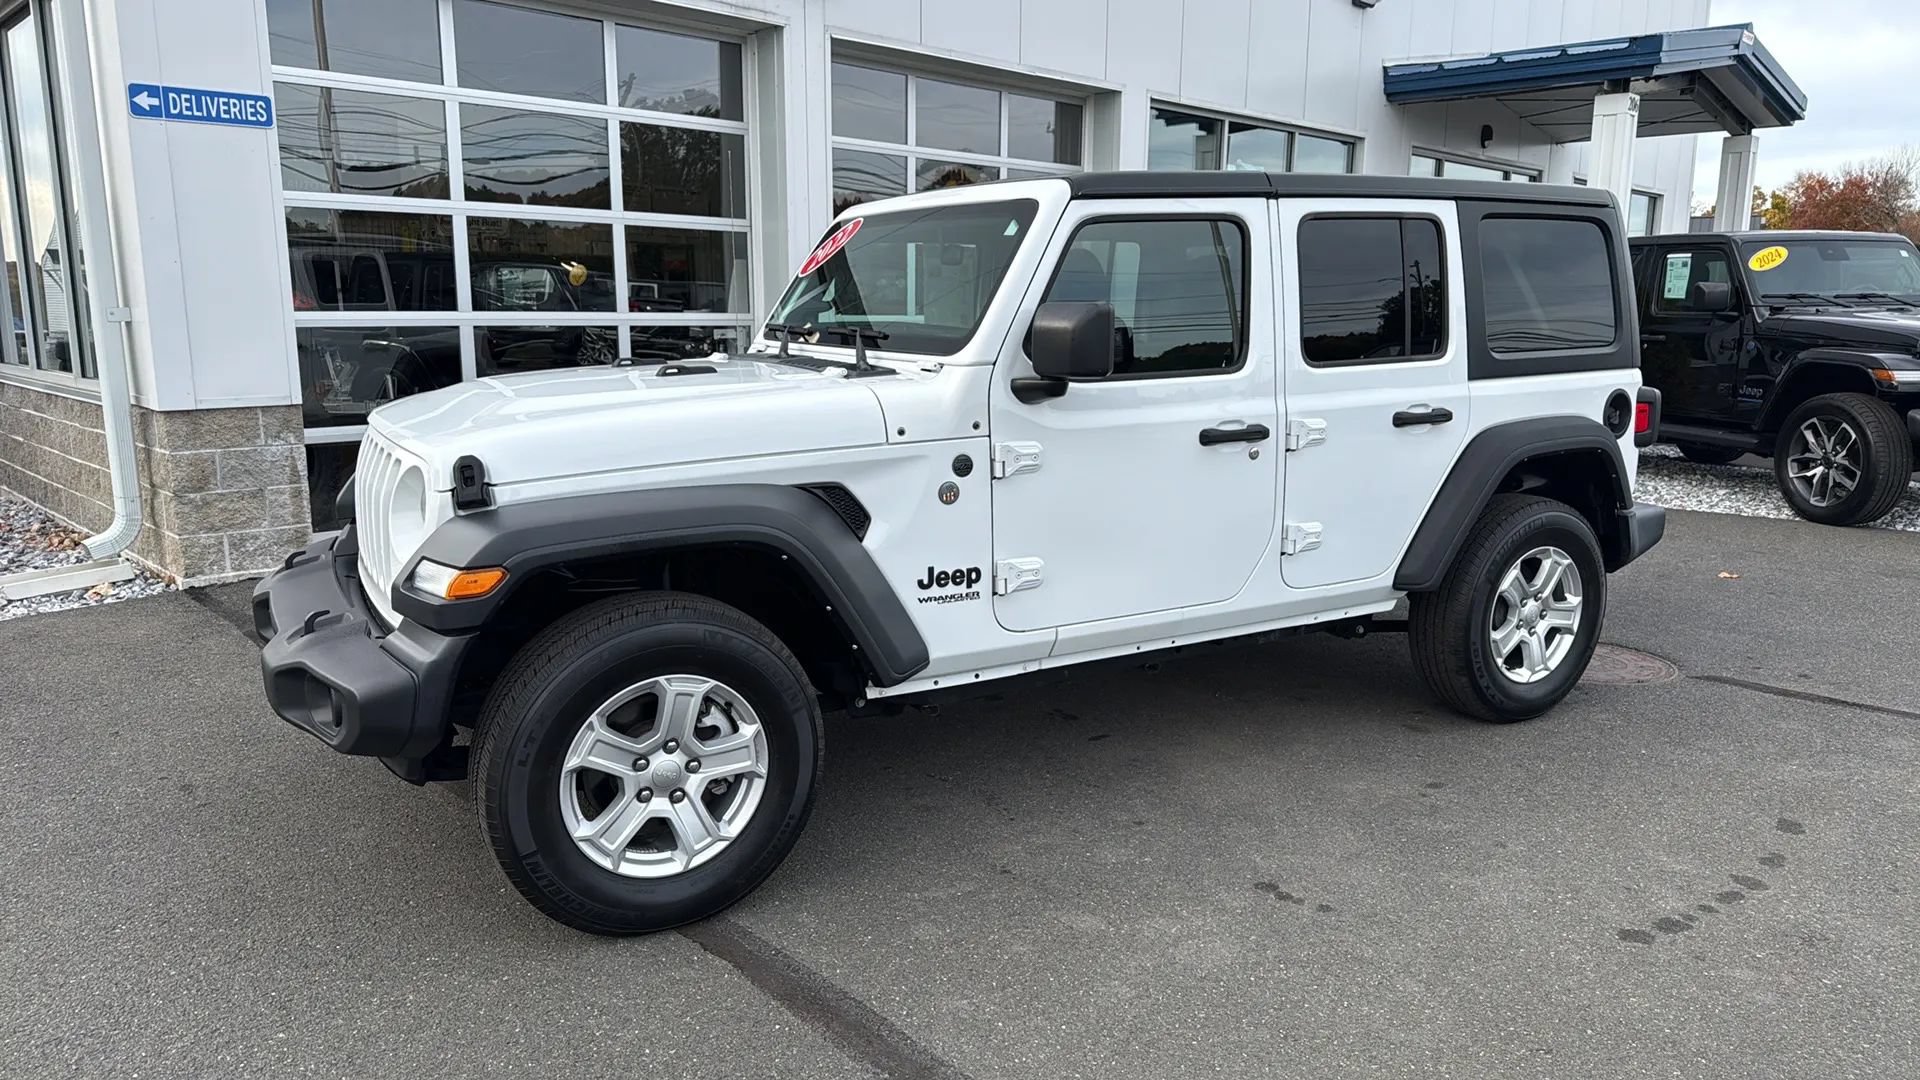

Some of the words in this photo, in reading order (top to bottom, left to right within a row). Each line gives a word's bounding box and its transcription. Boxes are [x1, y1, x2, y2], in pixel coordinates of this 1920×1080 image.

[168, 92, 268, 122] DELIVERIES
[806, 223, 854, 271] 2022
[1755, 248, 1783, 269] 2024
[1739, 384, 1763, 399] Jeep
[917, 566, 982, 590] Jeep
[917, 591, 980, 604] WRANGLER
